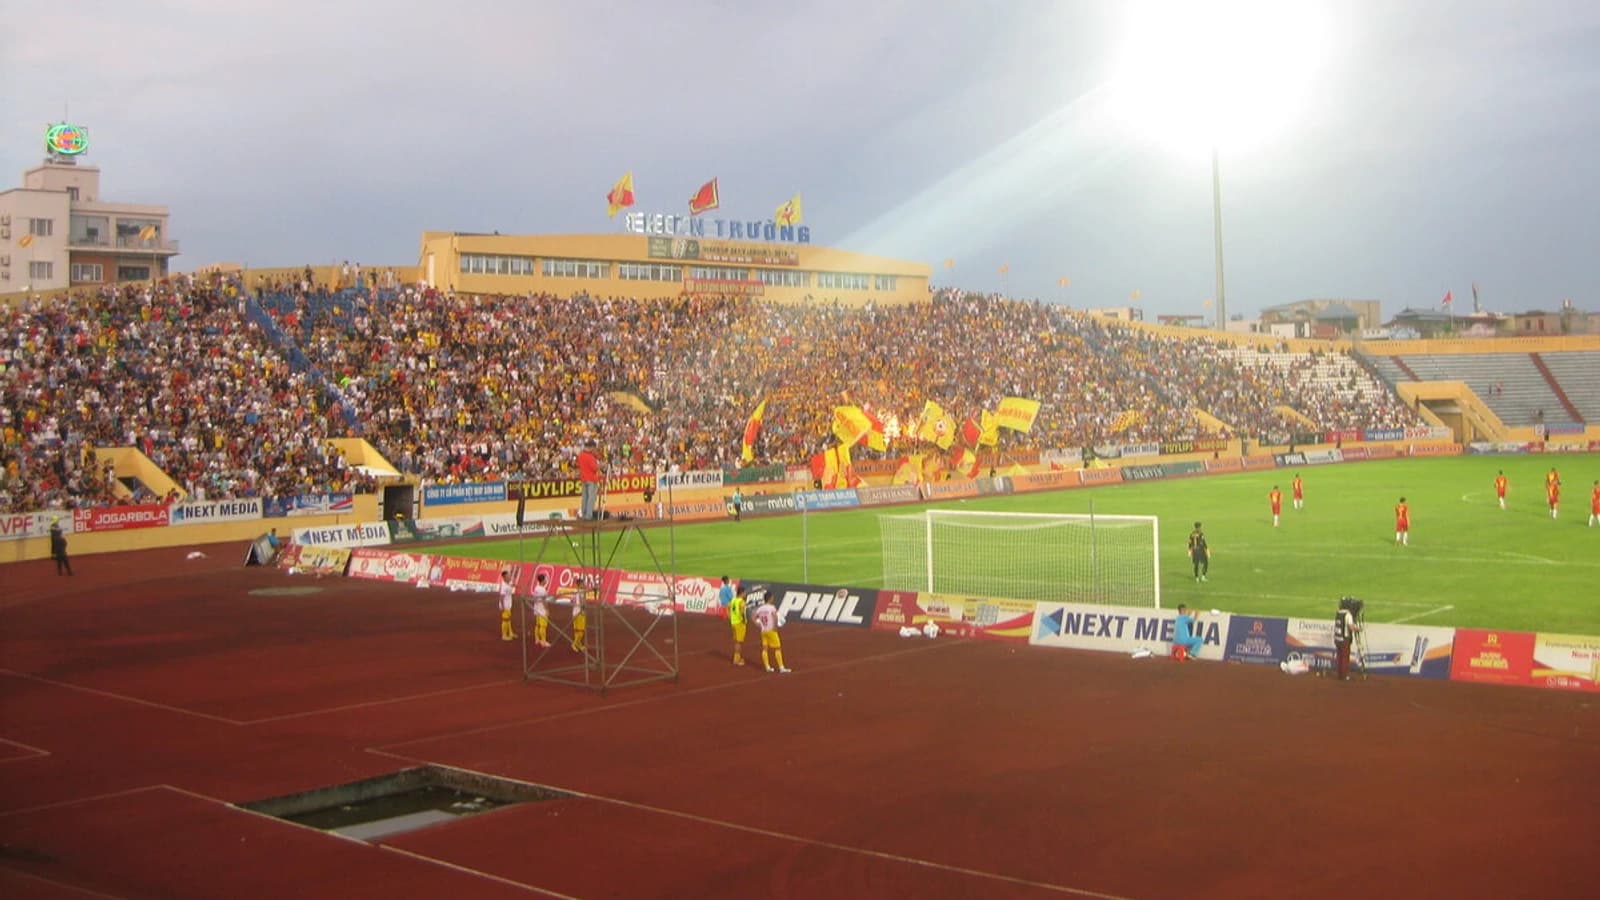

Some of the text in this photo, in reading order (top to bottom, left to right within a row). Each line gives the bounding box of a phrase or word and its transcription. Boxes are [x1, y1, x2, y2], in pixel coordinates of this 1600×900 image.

[692, 473, 721, 484] MEDIA
[523, 481, 583, 497] TUYLIPS
[75, 509, 92, 521] JG
[185, 502, 259, 518] NEXT MEDIA
[0, 514, 33, 535] VPF
[95, 511, 168, 525] JOGARBOLA
[75, 521, 92, 532] BL
[311, 529, 343, 545] NEXT
[347, 525, 387, 542] MEDIA
[675, 583, 706, 598] SKIN
[1064, 612, 1130, 638] NEXT
[1134, 617, 1221, 646] MEIA
